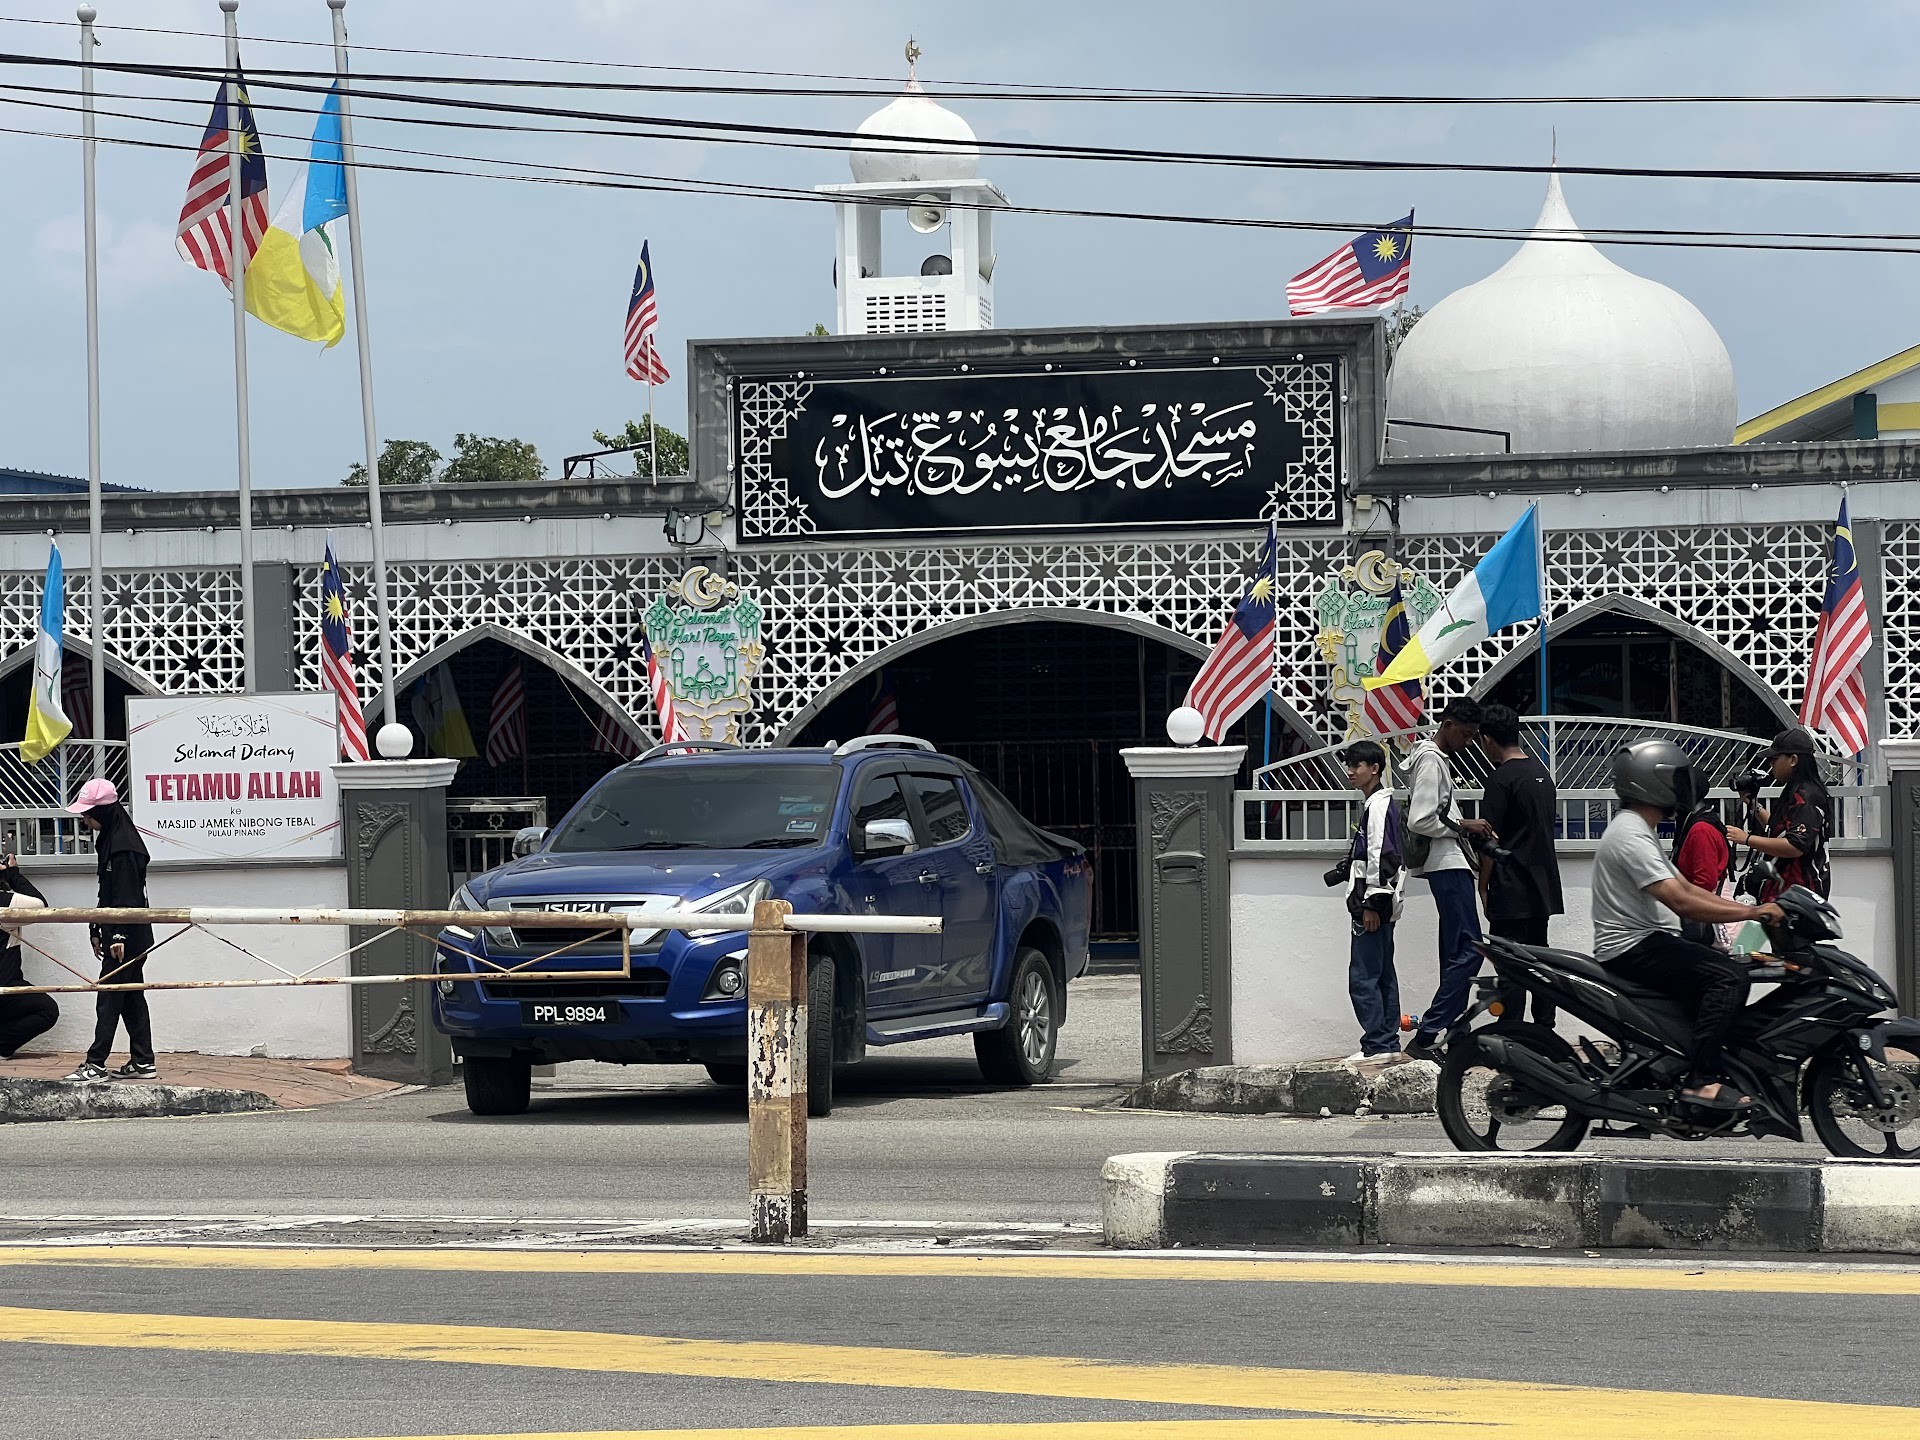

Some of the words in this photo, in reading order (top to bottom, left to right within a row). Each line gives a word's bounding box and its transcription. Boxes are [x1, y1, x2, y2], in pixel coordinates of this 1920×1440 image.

[673, 608, 732, 626] Selamat
[668, 629, 701, 645] Hari
[702, 627, 738, 648] Raya
[174, 743, 236, 763] Selamat
[240, 743, 295, 763] Datang
[145, 772, 242, 802] TETAMU
[247, 770, 322, 800] ALLAH
[230, 806, 242, 815] ke
[157, 819, 197, 830] MASJID
[199, 818, 235, 829] JAMEK
[239, 818, 283, 828] NIBONG
[285, 817, 316, 827] TEBAL
[207, 829, 232, 837] PULAU
[234, 828, 266, 837] PINANG
